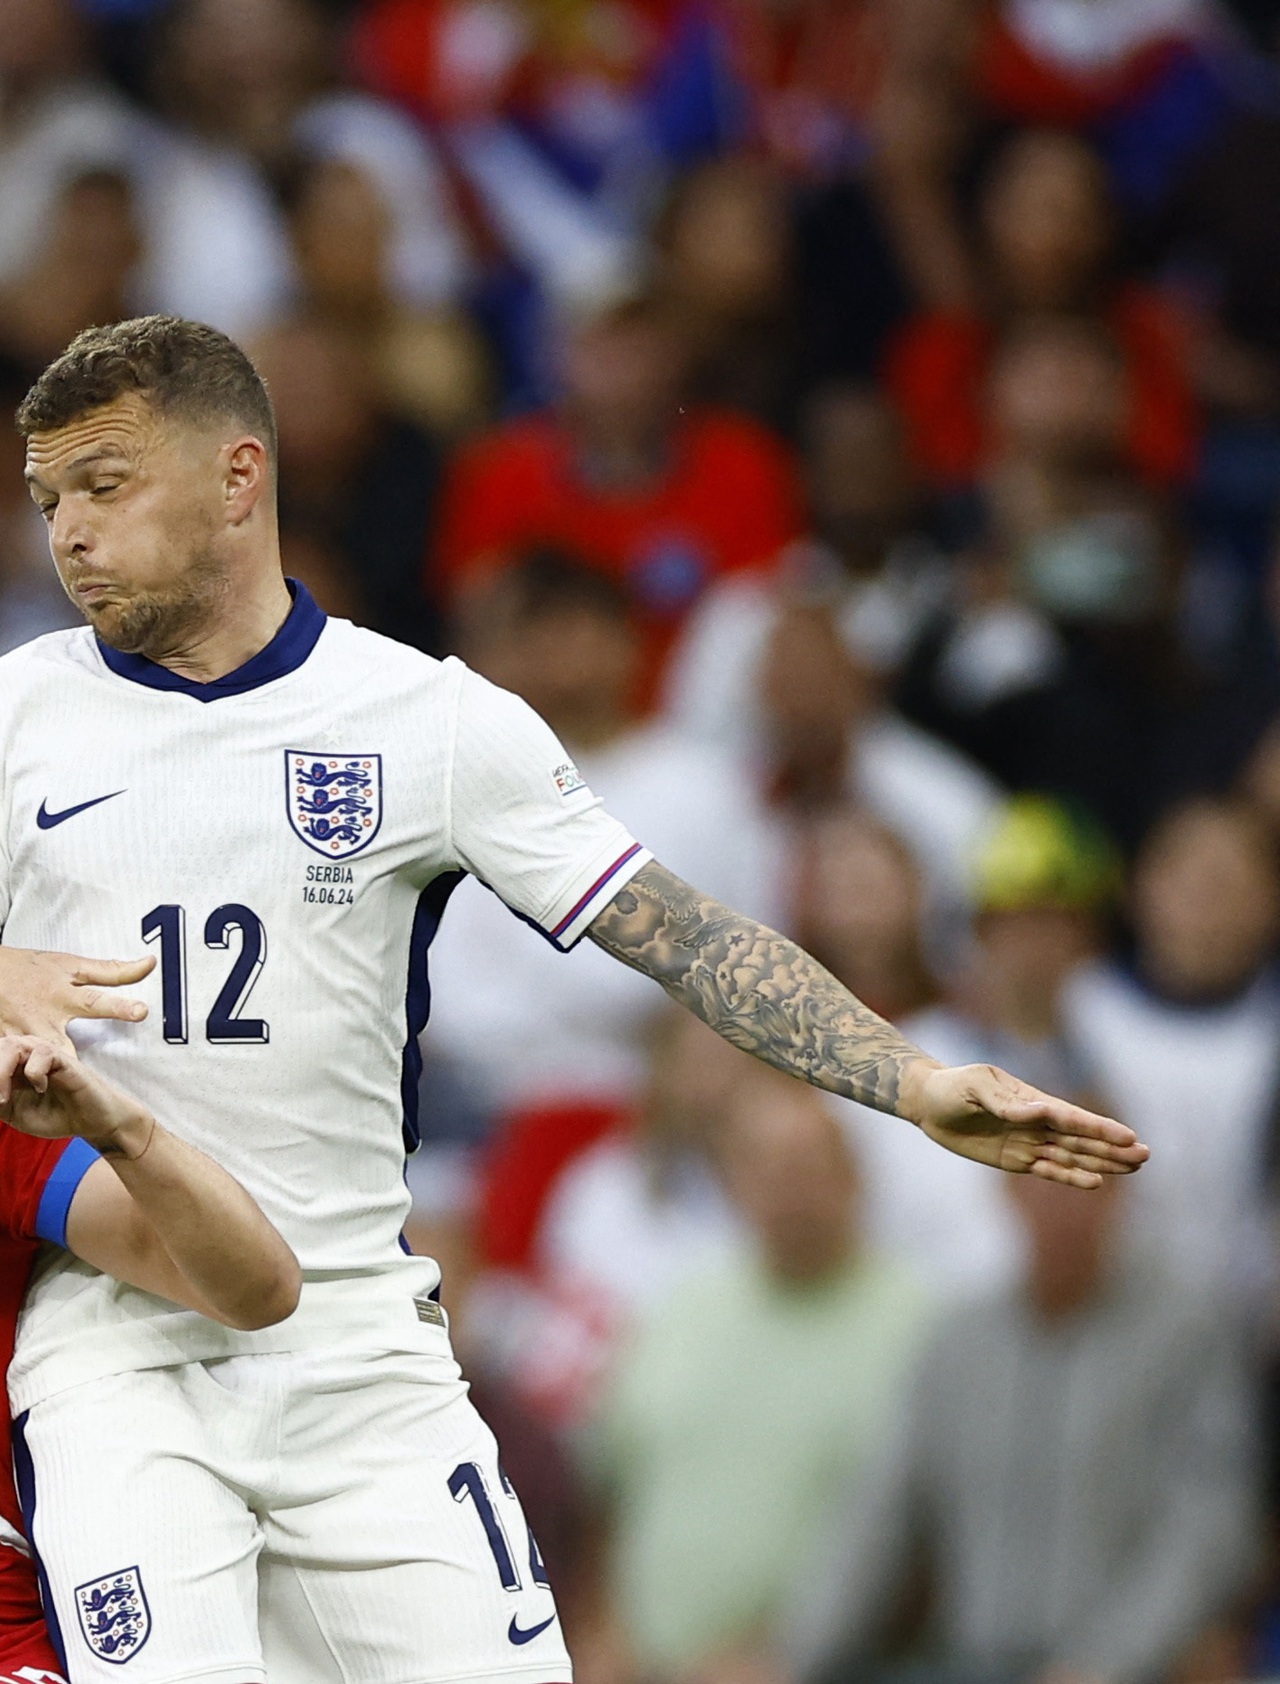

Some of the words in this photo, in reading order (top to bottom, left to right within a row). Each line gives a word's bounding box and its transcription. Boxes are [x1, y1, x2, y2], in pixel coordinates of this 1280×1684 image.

[306, 865, 353, 883] SERBIA
[303, 886, 354, 905] 16.06.24
[142, 903, 269, 1044] 12
